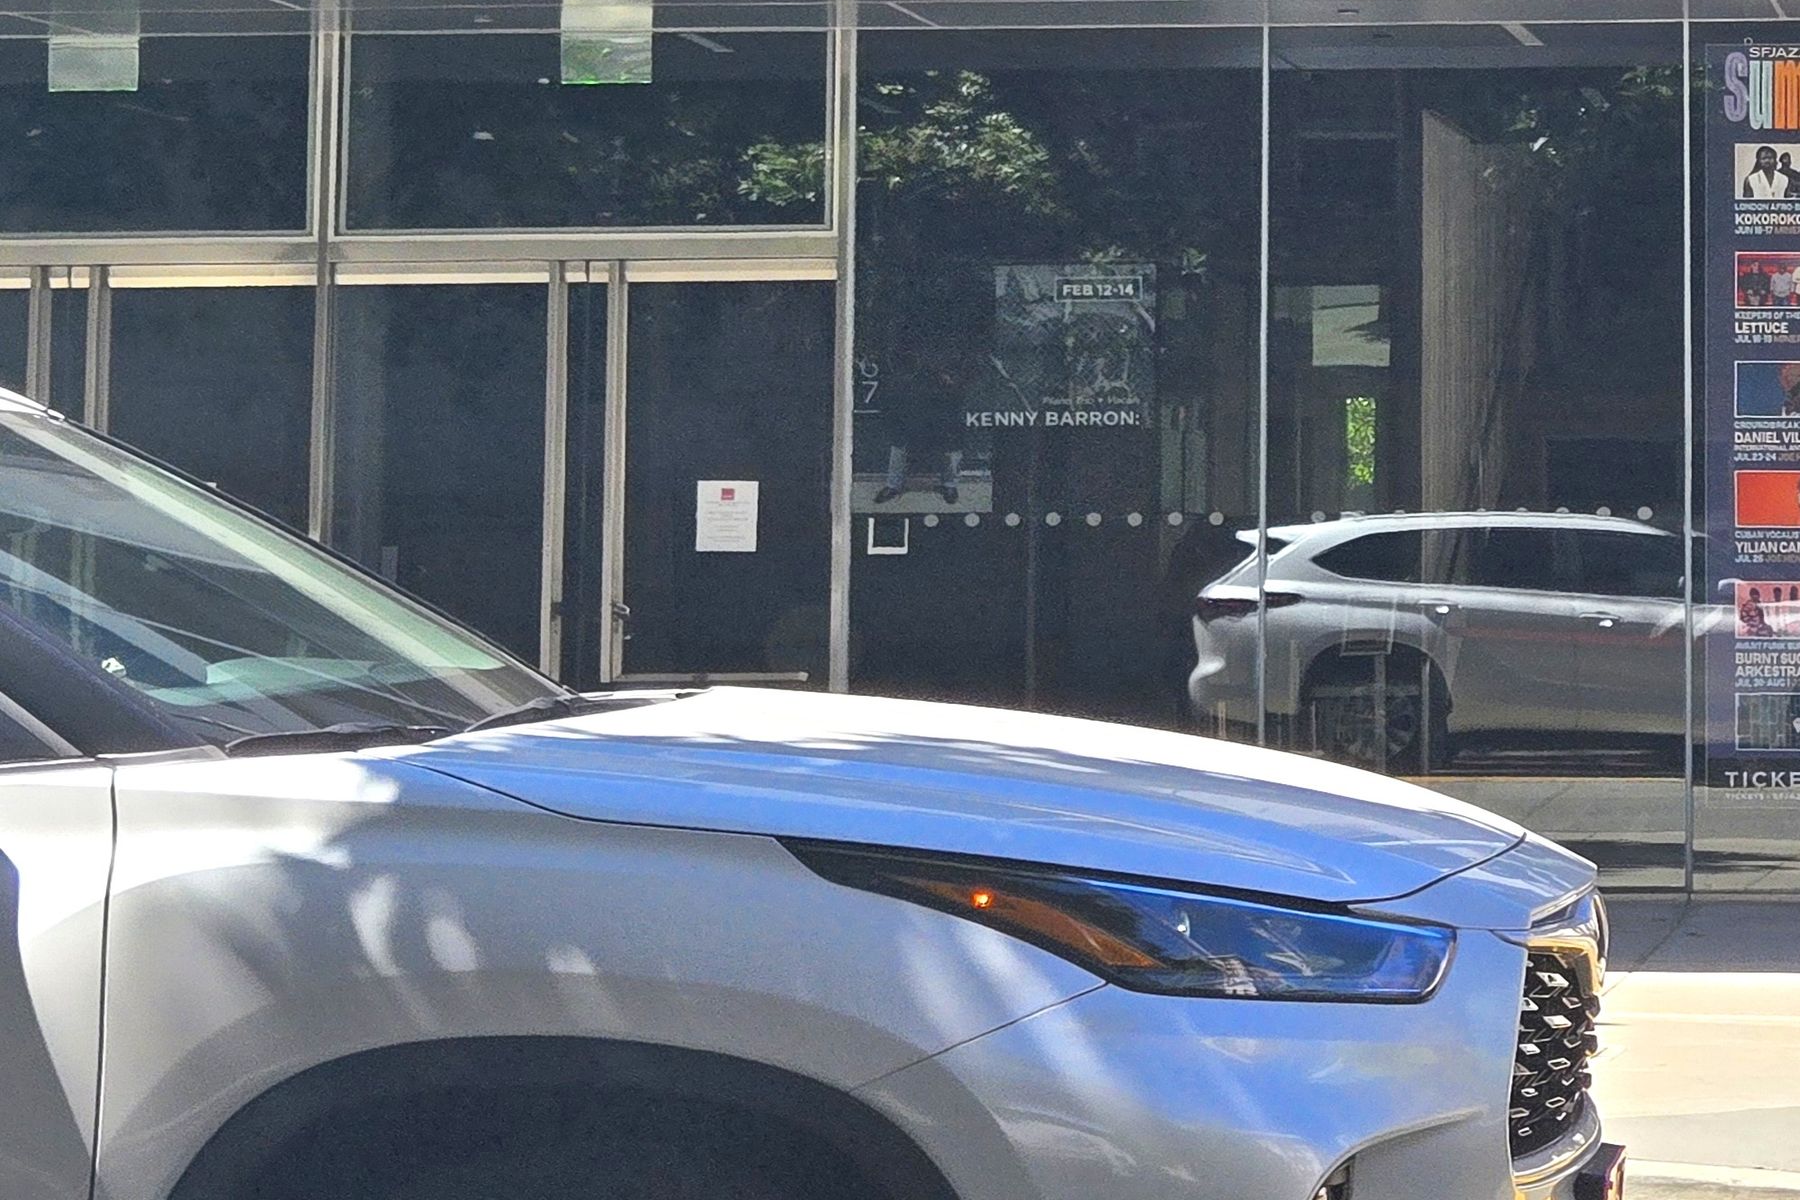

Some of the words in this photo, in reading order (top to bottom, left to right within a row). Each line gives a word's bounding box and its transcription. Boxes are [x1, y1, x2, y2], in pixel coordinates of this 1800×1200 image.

[1734, 226, 1753, 236] JUN
[1062, 284, 1094, 296] FEB
[1735, 322, 1789, 334] LETTUCE
[1734, 334, 1752, 344] JUL
[966, 411, 1039, 427] KENNY
[1045, 411, 1141, 427] BARRON:
[1734, 431, 1781, 444] DANIEL
[1733, 452, 1751, 462] JUL
[1734, 541, 1778, 554] YILIAN
[1734, 554, 1752, 564] JUL
[1735, 652, 1779, 665] BURNT
